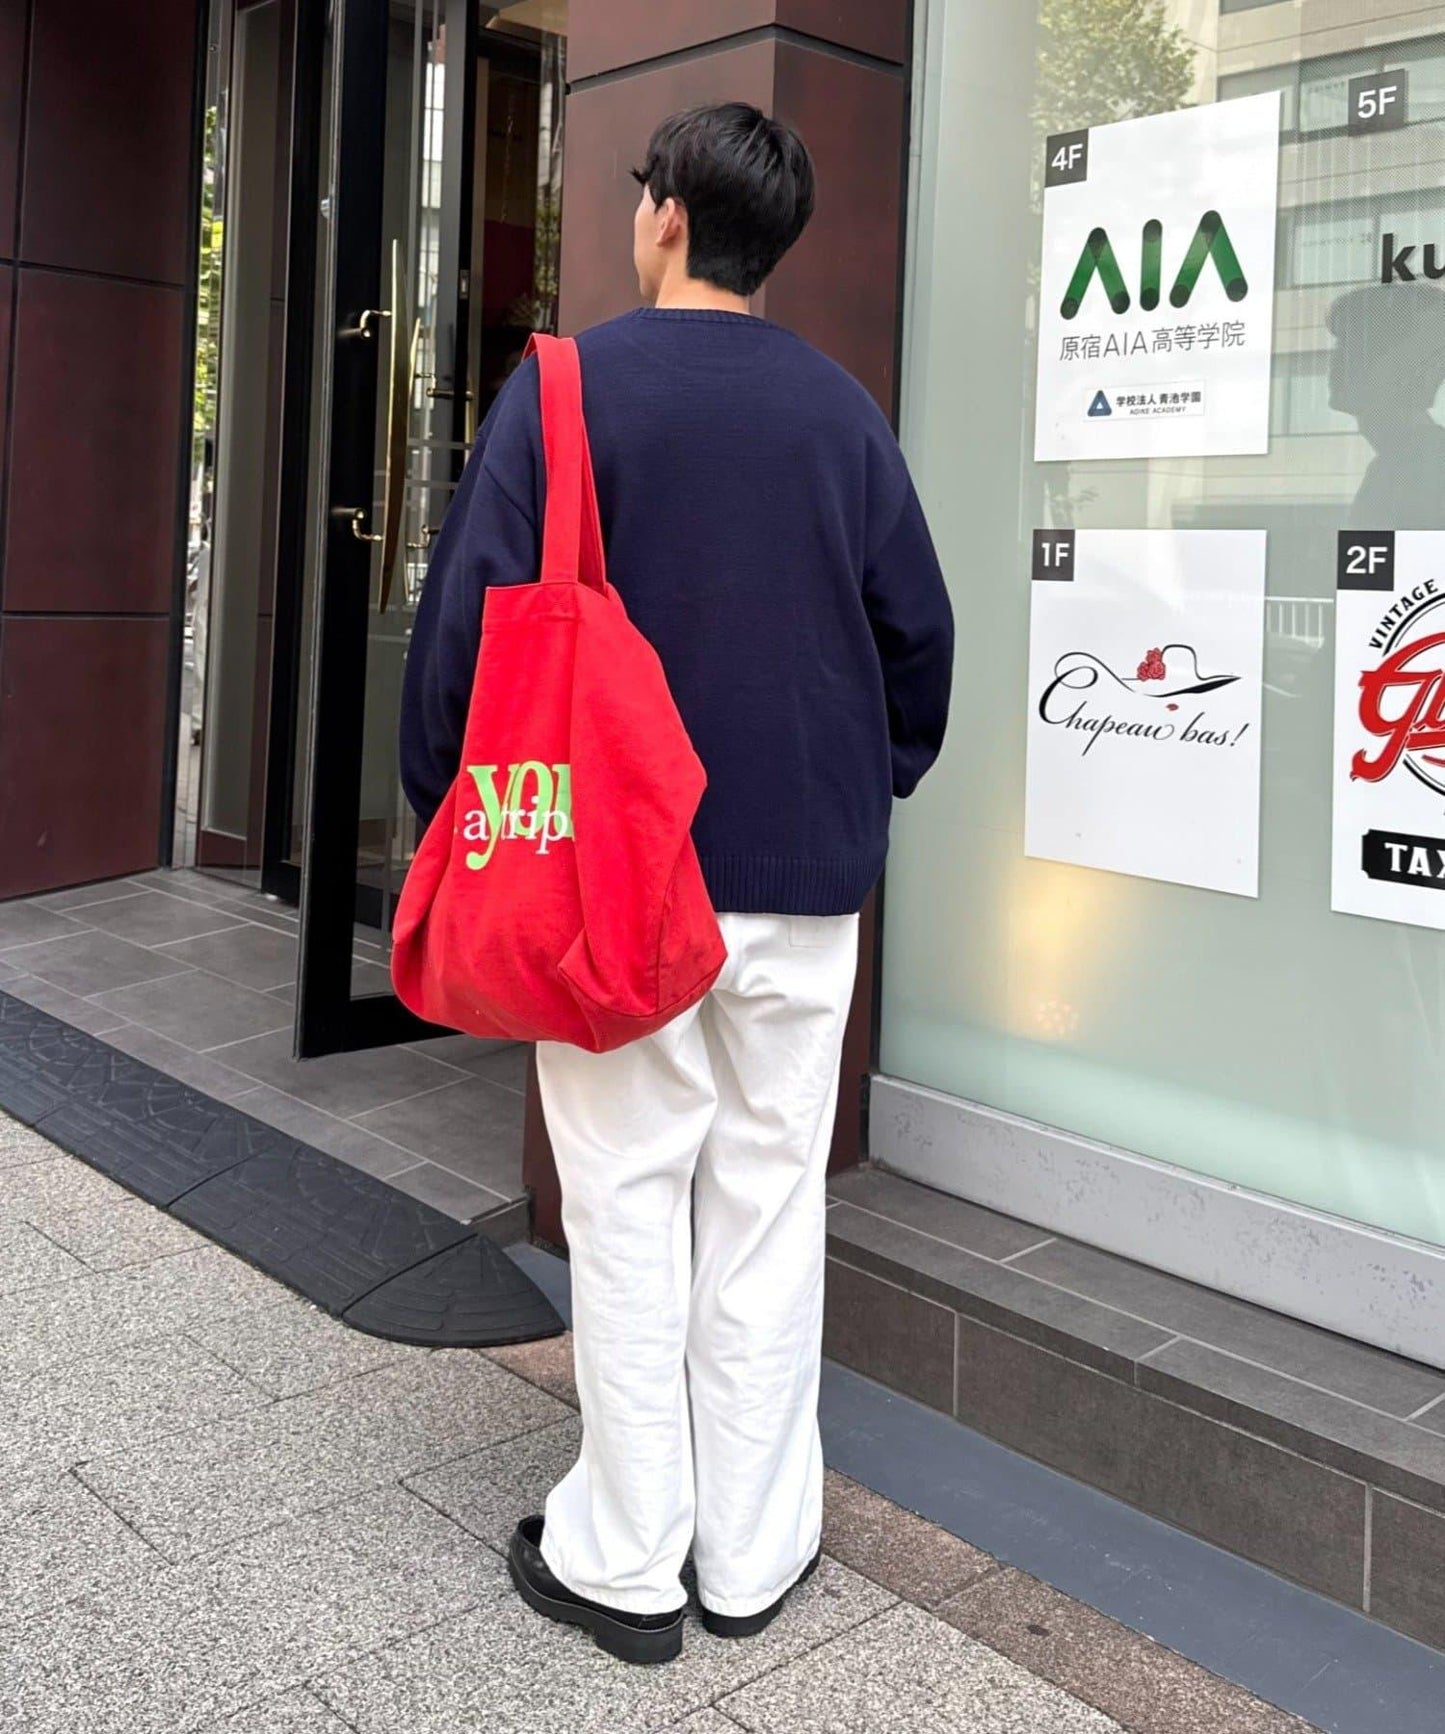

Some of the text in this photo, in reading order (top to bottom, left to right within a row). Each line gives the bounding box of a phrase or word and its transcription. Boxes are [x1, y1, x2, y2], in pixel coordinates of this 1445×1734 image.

[1357, 86, 1397, 119] 5F
[1052, 143, 1084, 171] 4F
[1060, 210, 1248, 320] AIA
[1059, 320, 1246, 361] 原宿AIA高等学院
[1152, 405, 1187, 414] ACADEMY
[1041, 542, 1070, 567] 1F
[1346, 546, 1388, 574] 2F
[1368, 578, 1439, 649] VINTAGE
[1038, 665, 1250, 757] Chapeau bas!
